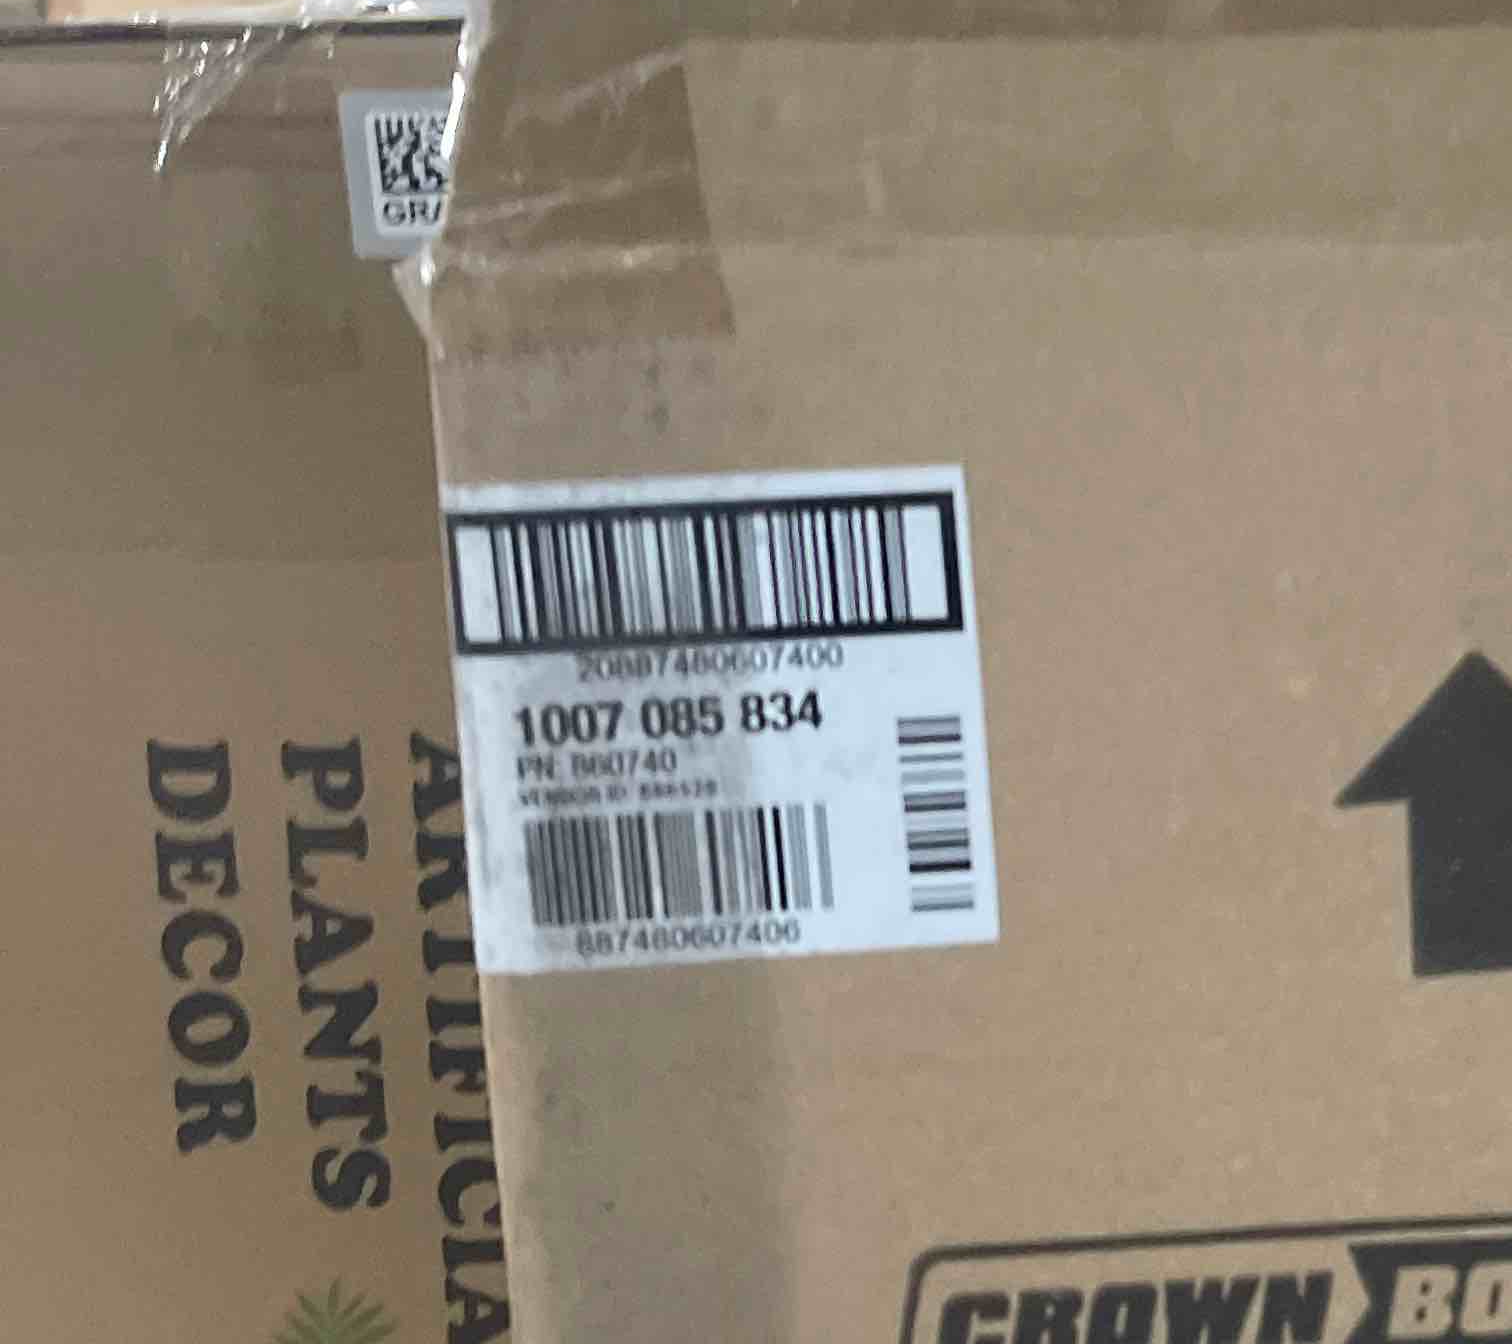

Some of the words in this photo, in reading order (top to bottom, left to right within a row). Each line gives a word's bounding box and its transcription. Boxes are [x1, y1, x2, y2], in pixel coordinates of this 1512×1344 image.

[514, 699, 624, 748] 1007
[640, 694, 725, 739] 085
[740, 687, 823, 735] 834
[146, 737, 258, 1154] DECOR
[281, 736, 391, 1213] PLANTS
